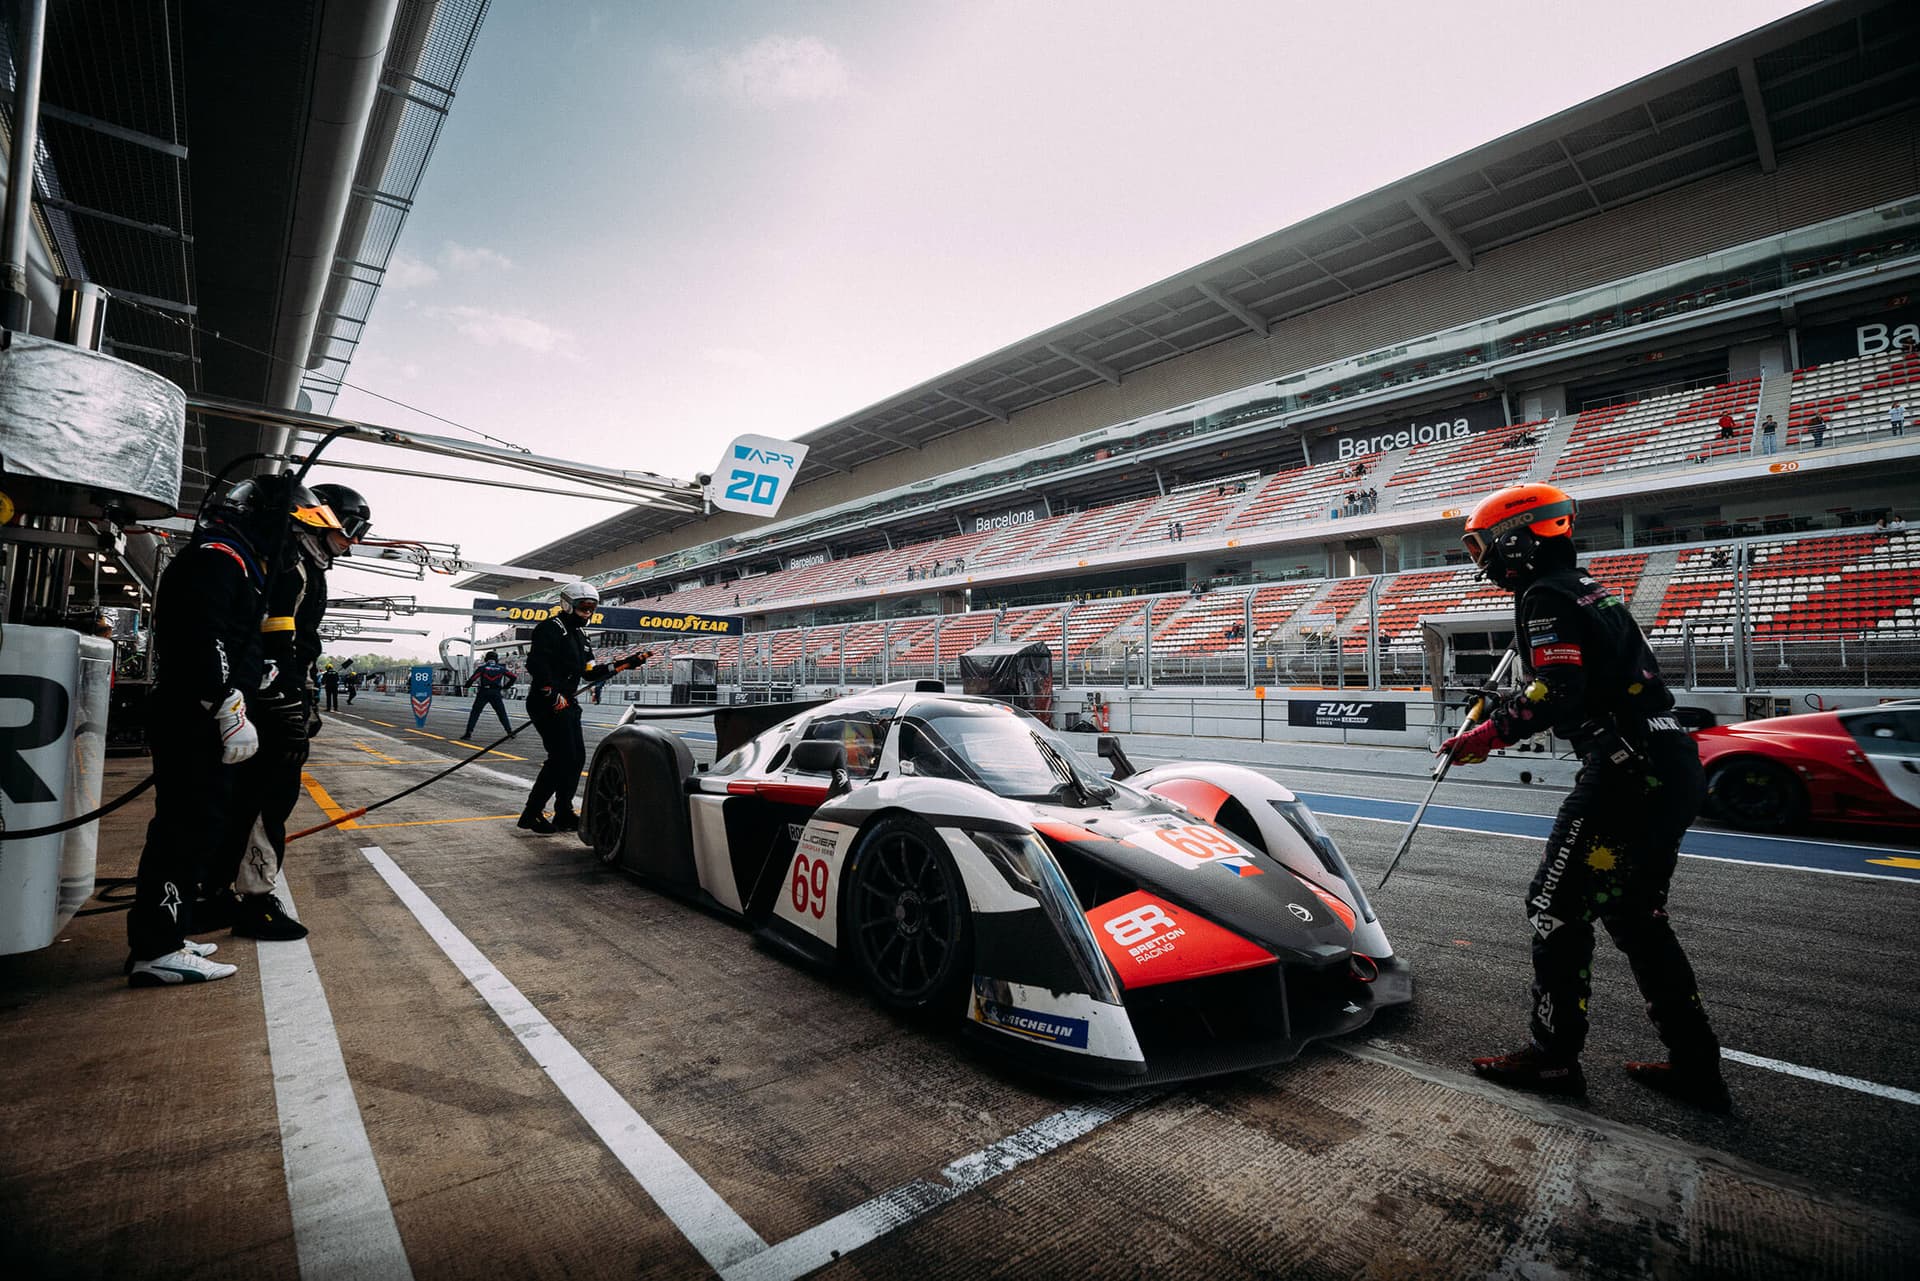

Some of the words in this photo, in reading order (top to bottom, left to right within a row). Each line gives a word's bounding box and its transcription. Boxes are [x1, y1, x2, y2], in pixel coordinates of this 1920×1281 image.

[1338, 417, 1470, 460] Barcelona
[749, 449, 795, 470] APR
[1781, 462, 1797, 471] 20
[725, 469, 780, 506] 20
[976, 510, 1034, 532] Barcelona
[1491, 511, 1535, 538] BRIKO
[496, 605, 604, 625] OODR
[639, 614, 729, 633] GOODYEAR
[415, 672, 429, 682] 88
[1316, 703, 1373, 716] ELMS
[0, 674, 69, 804] R
[1155, 825, 1240, 859] 69
[1531, 846, 1571, 910] Bretton
[1566, 818, 1585, 845] s.r.o.
[791, 853, 829, 920] 69
[1128, 927, 1186, 957] BRETTON
[1135, 942, 1176, 965] RACING
[1002, 1014, 1073, 1037] MICHELIN
